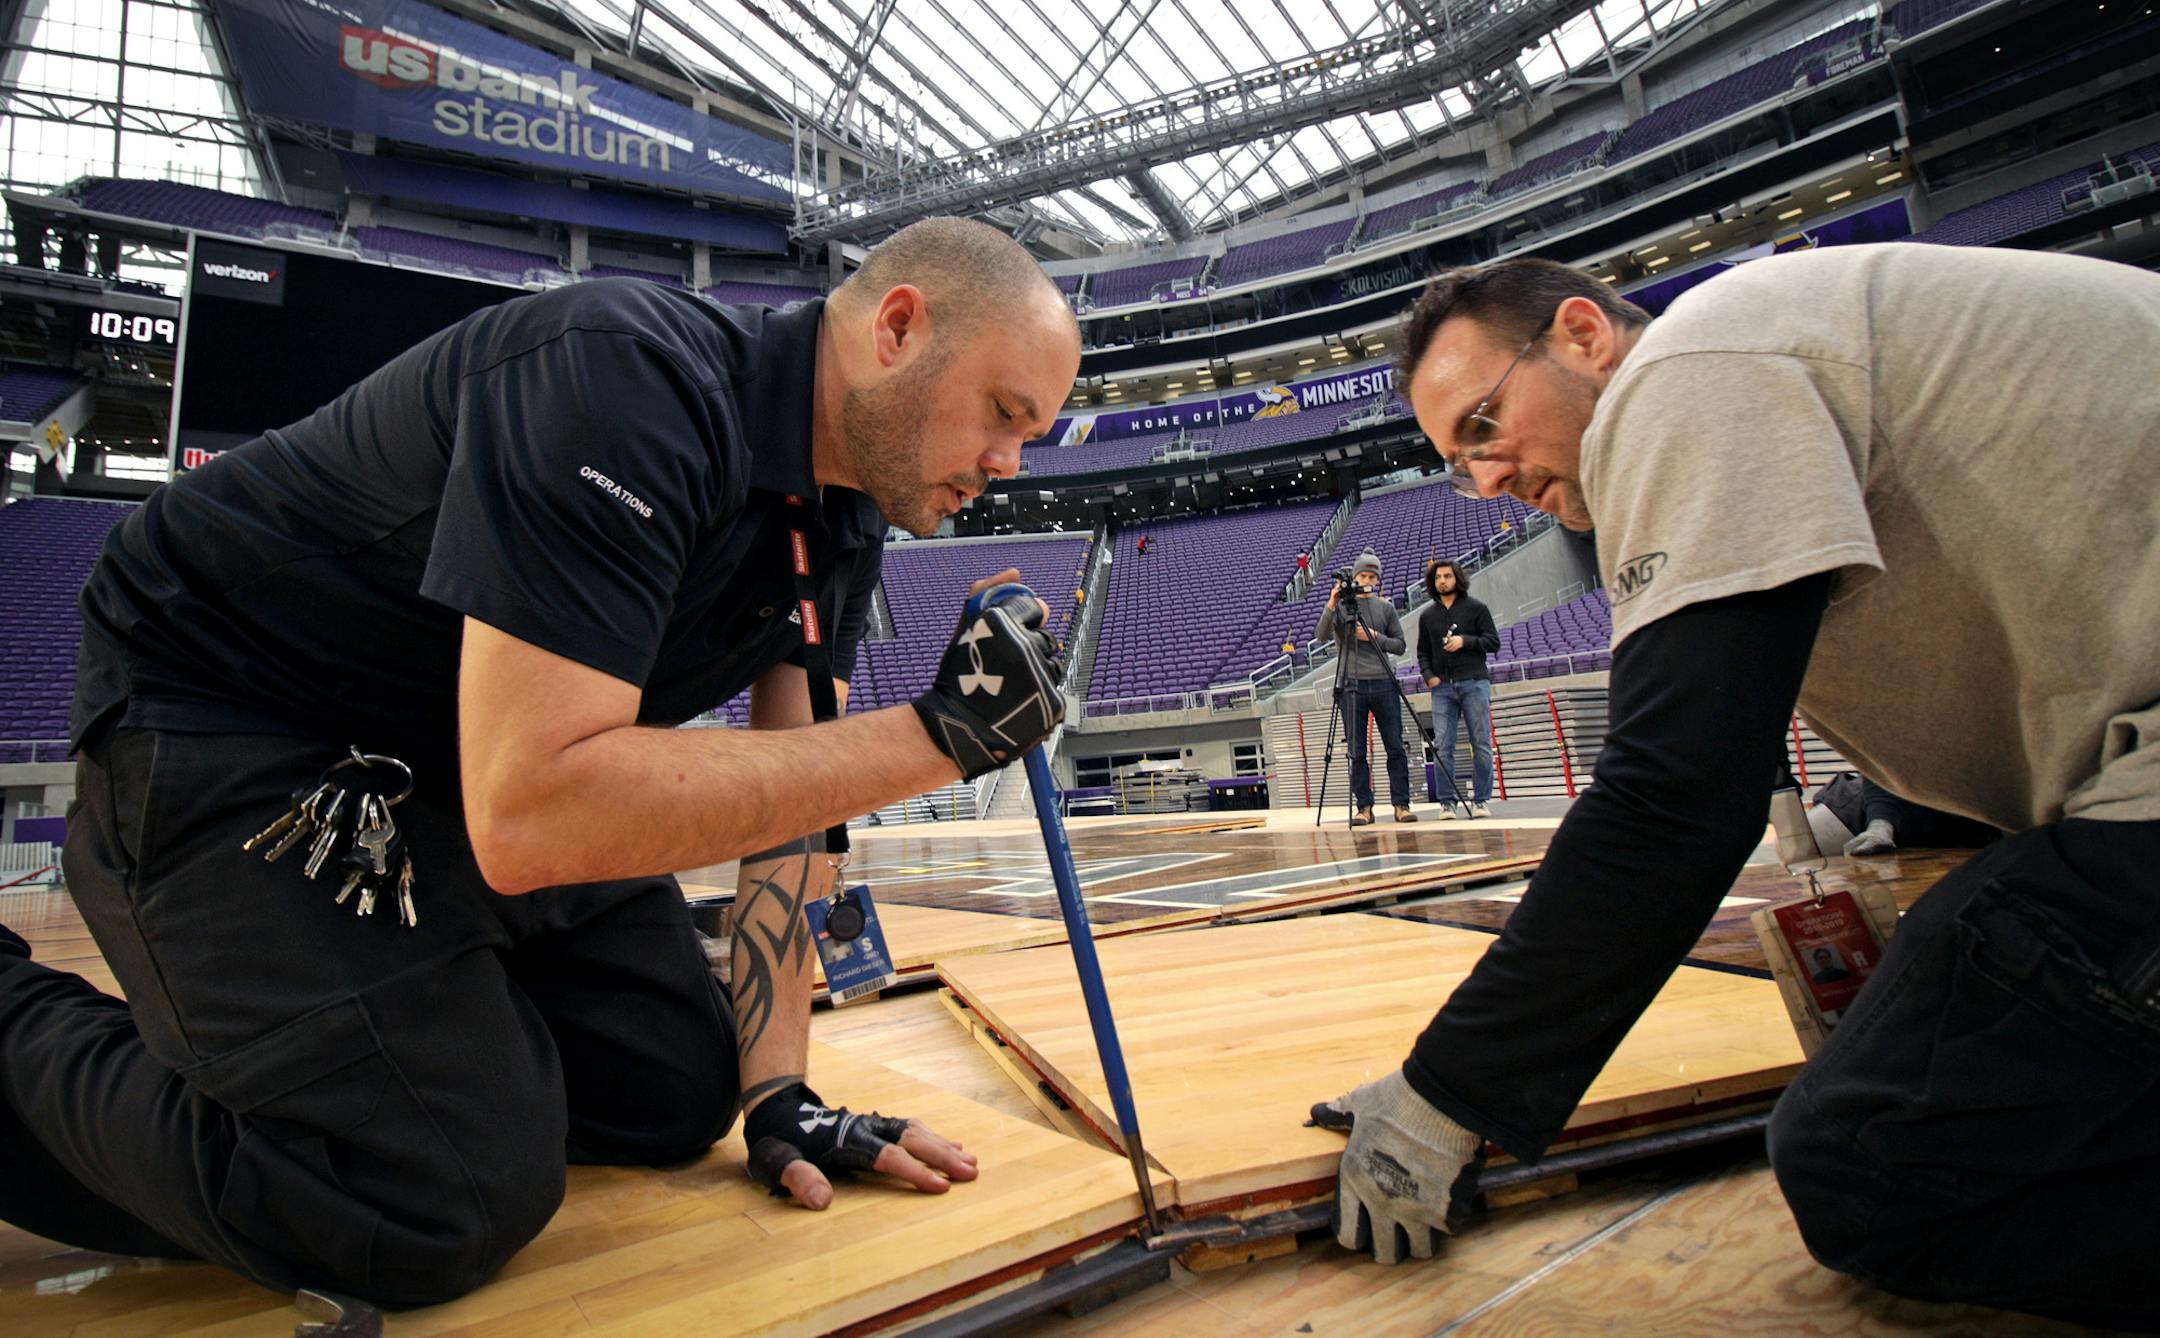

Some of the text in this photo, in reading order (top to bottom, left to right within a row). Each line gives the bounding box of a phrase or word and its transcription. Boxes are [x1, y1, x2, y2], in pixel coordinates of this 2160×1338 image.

[434, 98, 670, 172] stadium
[203, 262, 270, 283] verizon
[1340, 265, 1415, 299] SKOLVISION
[90, 312, 175, 344] 10:09
[1131, 369, 1394, 430] HOME OF THE MINNESOT
[579, 465, 654, 518] OPERATIONS
[804, 602, 817, 642] Skatelite
[861, 937, 873, 951] S
